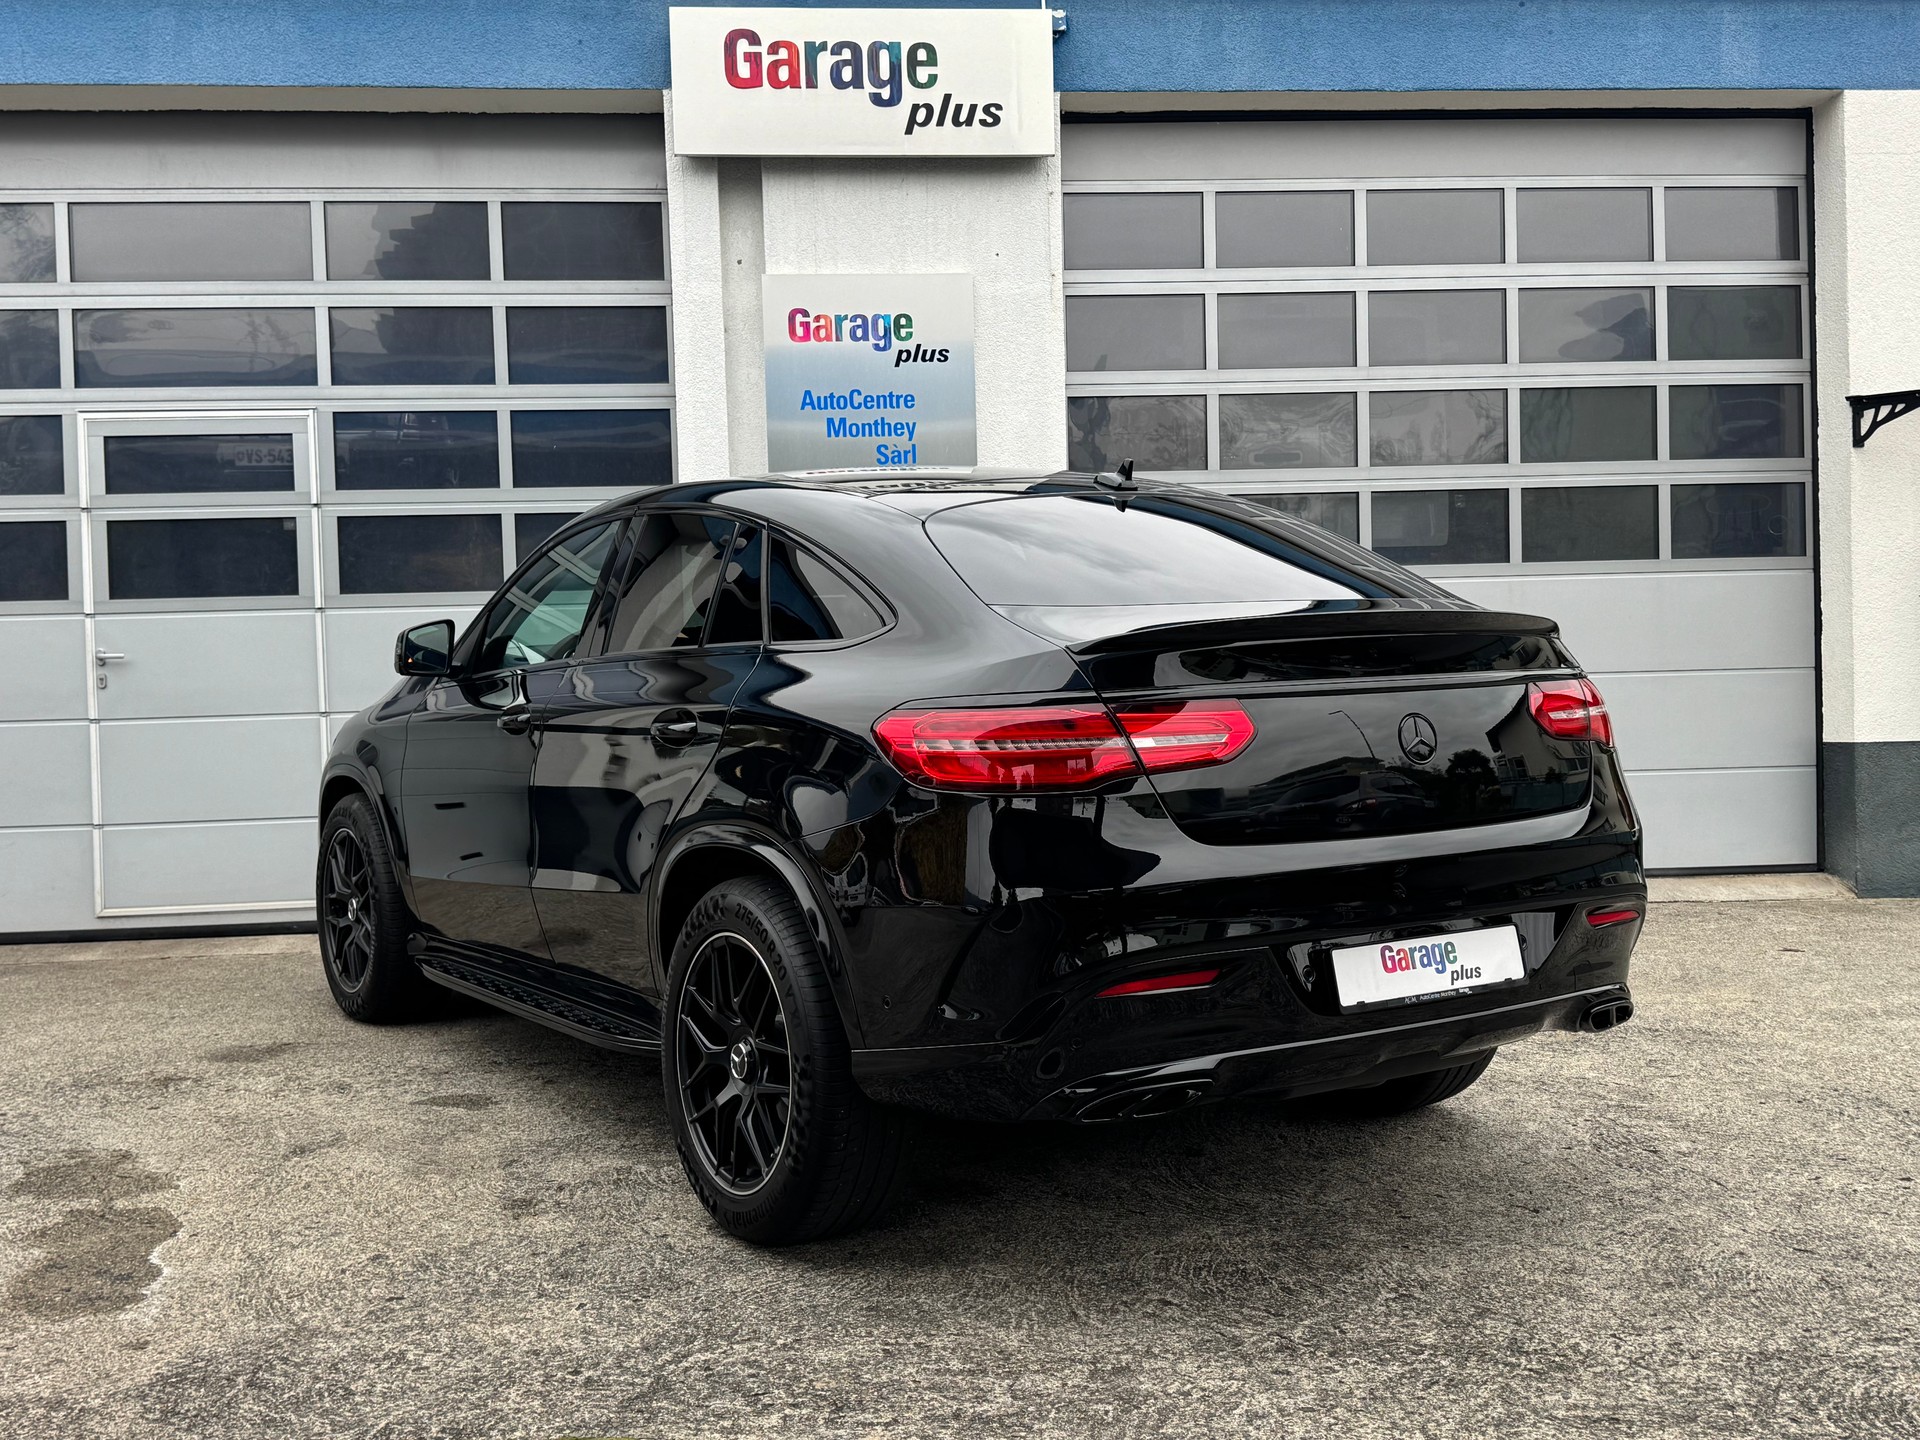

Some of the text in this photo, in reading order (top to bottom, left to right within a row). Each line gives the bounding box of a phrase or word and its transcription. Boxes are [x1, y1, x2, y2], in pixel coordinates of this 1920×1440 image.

[723, 28, 938, 108] Garage
[904, 94, 1003, 135] plus
[787, 307, 914, 352] Garage
[894, 344, 950, 367] plus
[800, 389, 916, 411] AutoCentre
[826, 416, 917, 441] Monthey
[876, 443, 917, 465] Sàrl
[1380, 941, 1458, 974] Garage
[1450, 964, 1482, 985] plus
